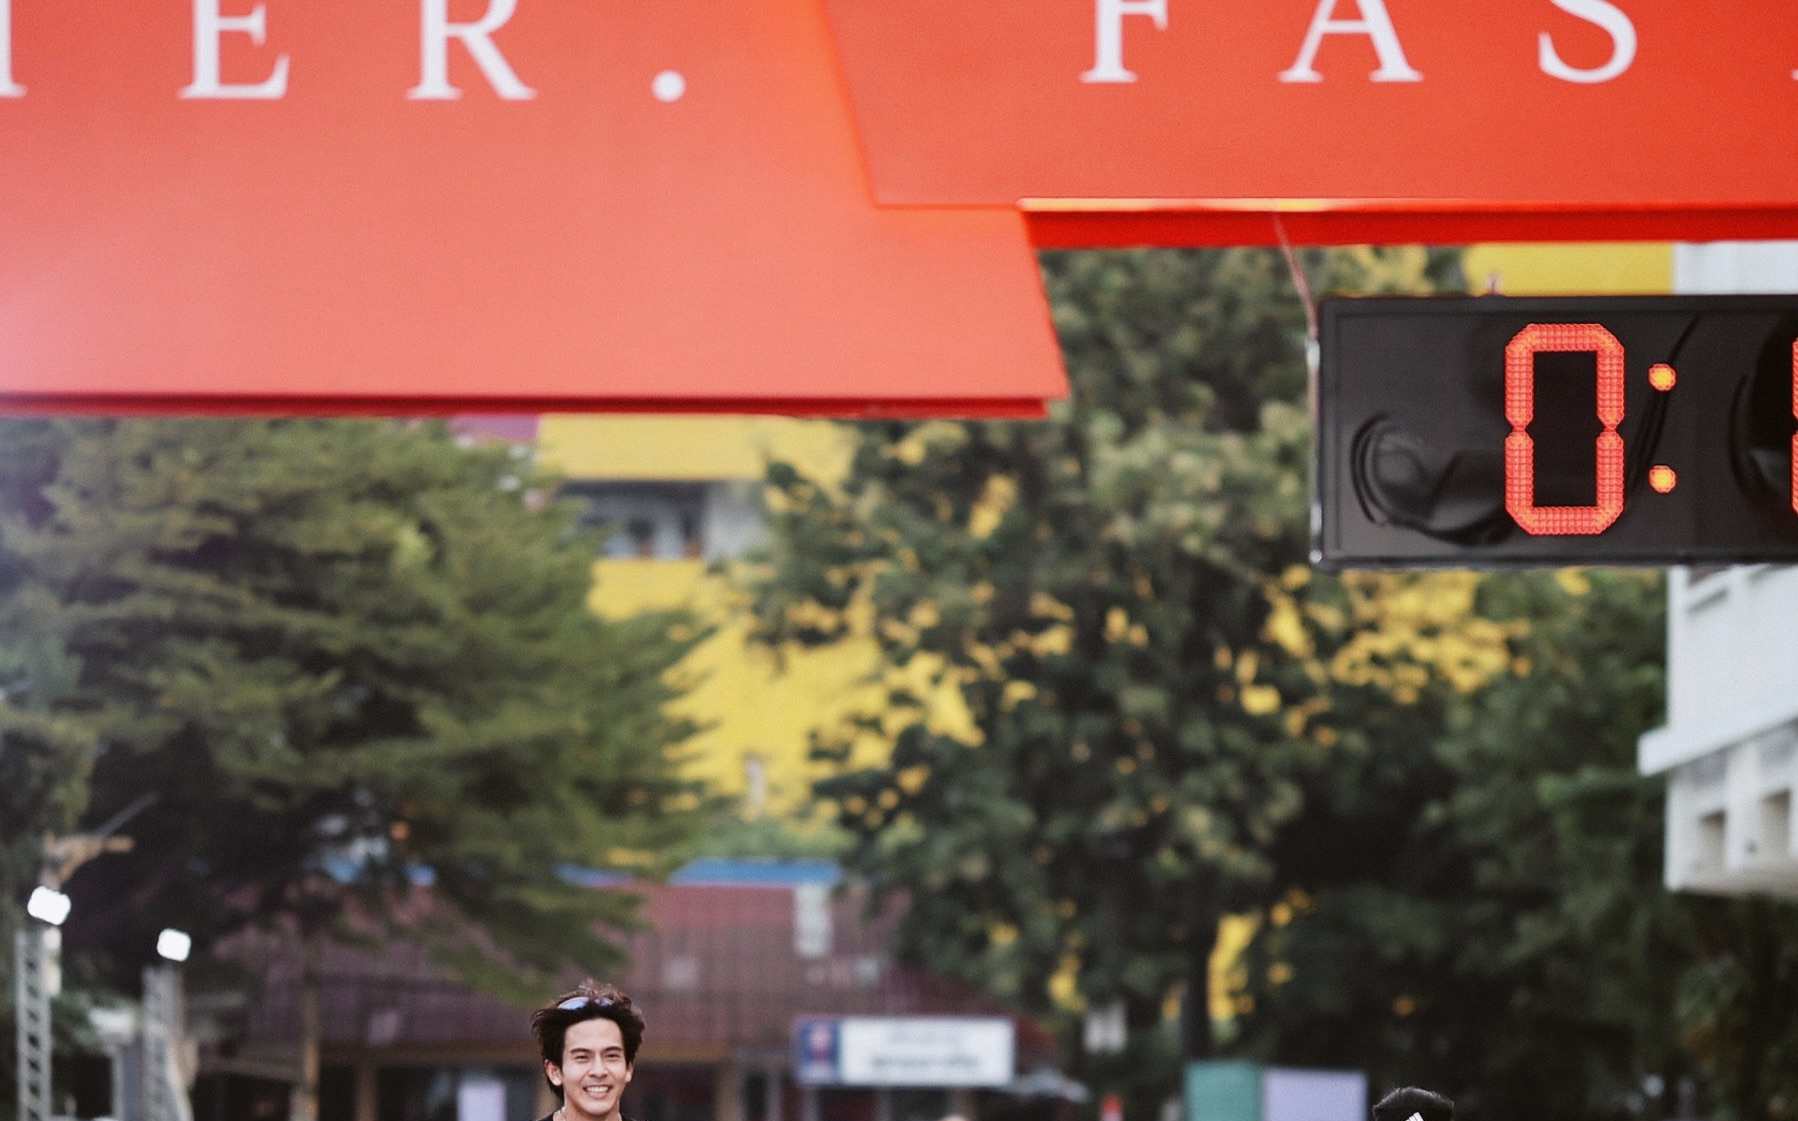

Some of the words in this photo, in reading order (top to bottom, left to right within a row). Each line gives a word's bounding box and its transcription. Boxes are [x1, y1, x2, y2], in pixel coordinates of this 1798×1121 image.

[0, 0, 687, 102] ER.
[1079, 0, 1798, 84] FAS
[1504, 322, 1798, 536] 0:
